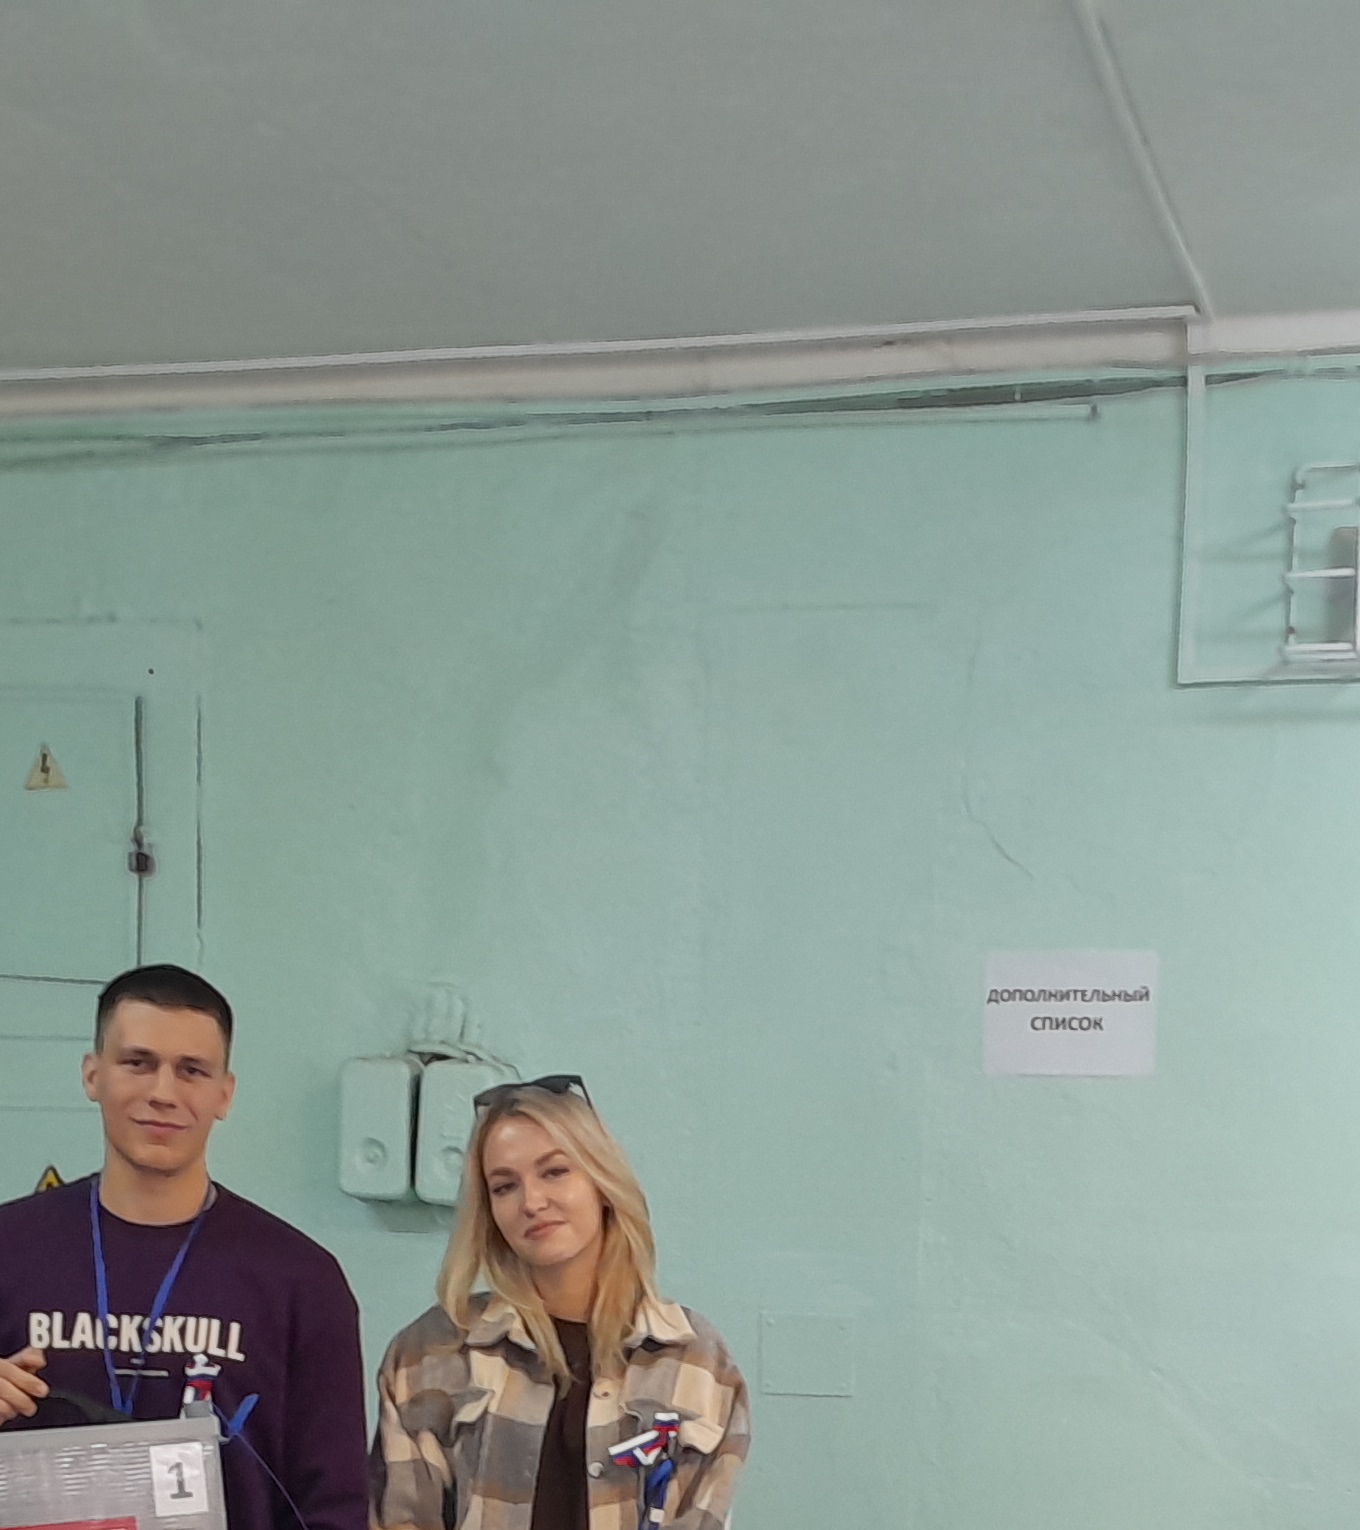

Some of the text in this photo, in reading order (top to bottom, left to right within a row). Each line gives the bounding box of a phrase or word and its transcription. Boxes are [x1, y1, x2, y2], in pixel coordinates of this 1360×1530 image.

[986, 986, 1150, 1004] ДОПОЛНИТЕЛЬНЫЙ
[1030, 1016, 1104, 1031] СПИСОК
[28, 1311, 246, 1362] BLACKSKULL
[167, 1461, 194, 1499] 1
